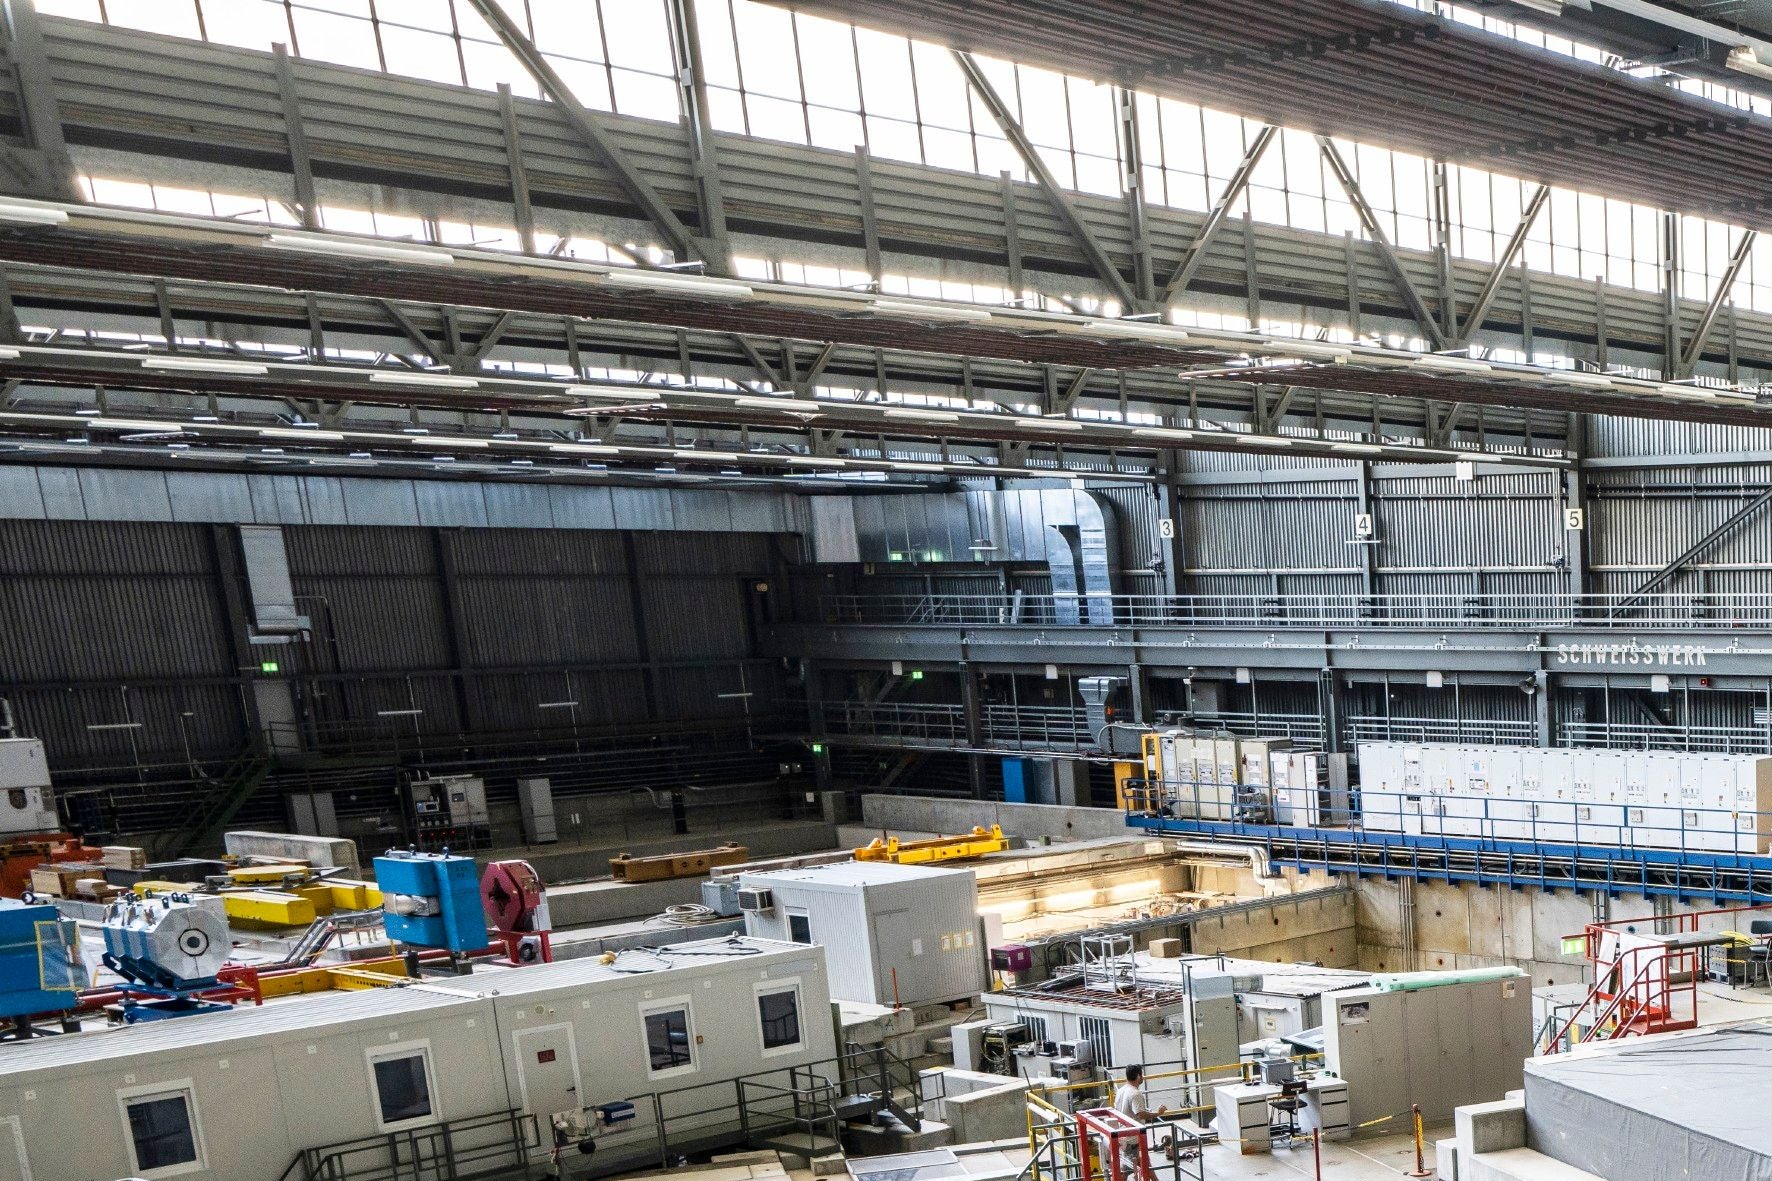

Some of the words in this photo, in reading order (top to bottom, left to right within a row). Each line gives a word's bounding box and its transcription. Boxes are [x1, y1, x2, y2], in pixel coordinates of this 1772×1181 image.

[1358, 516, 1368, 532] 4
[1569, 511, 1579, 528] 5
[1162, 520, 1171, 536] 3
[1557, 643, 1707, 666] SCHWEISSWERK
